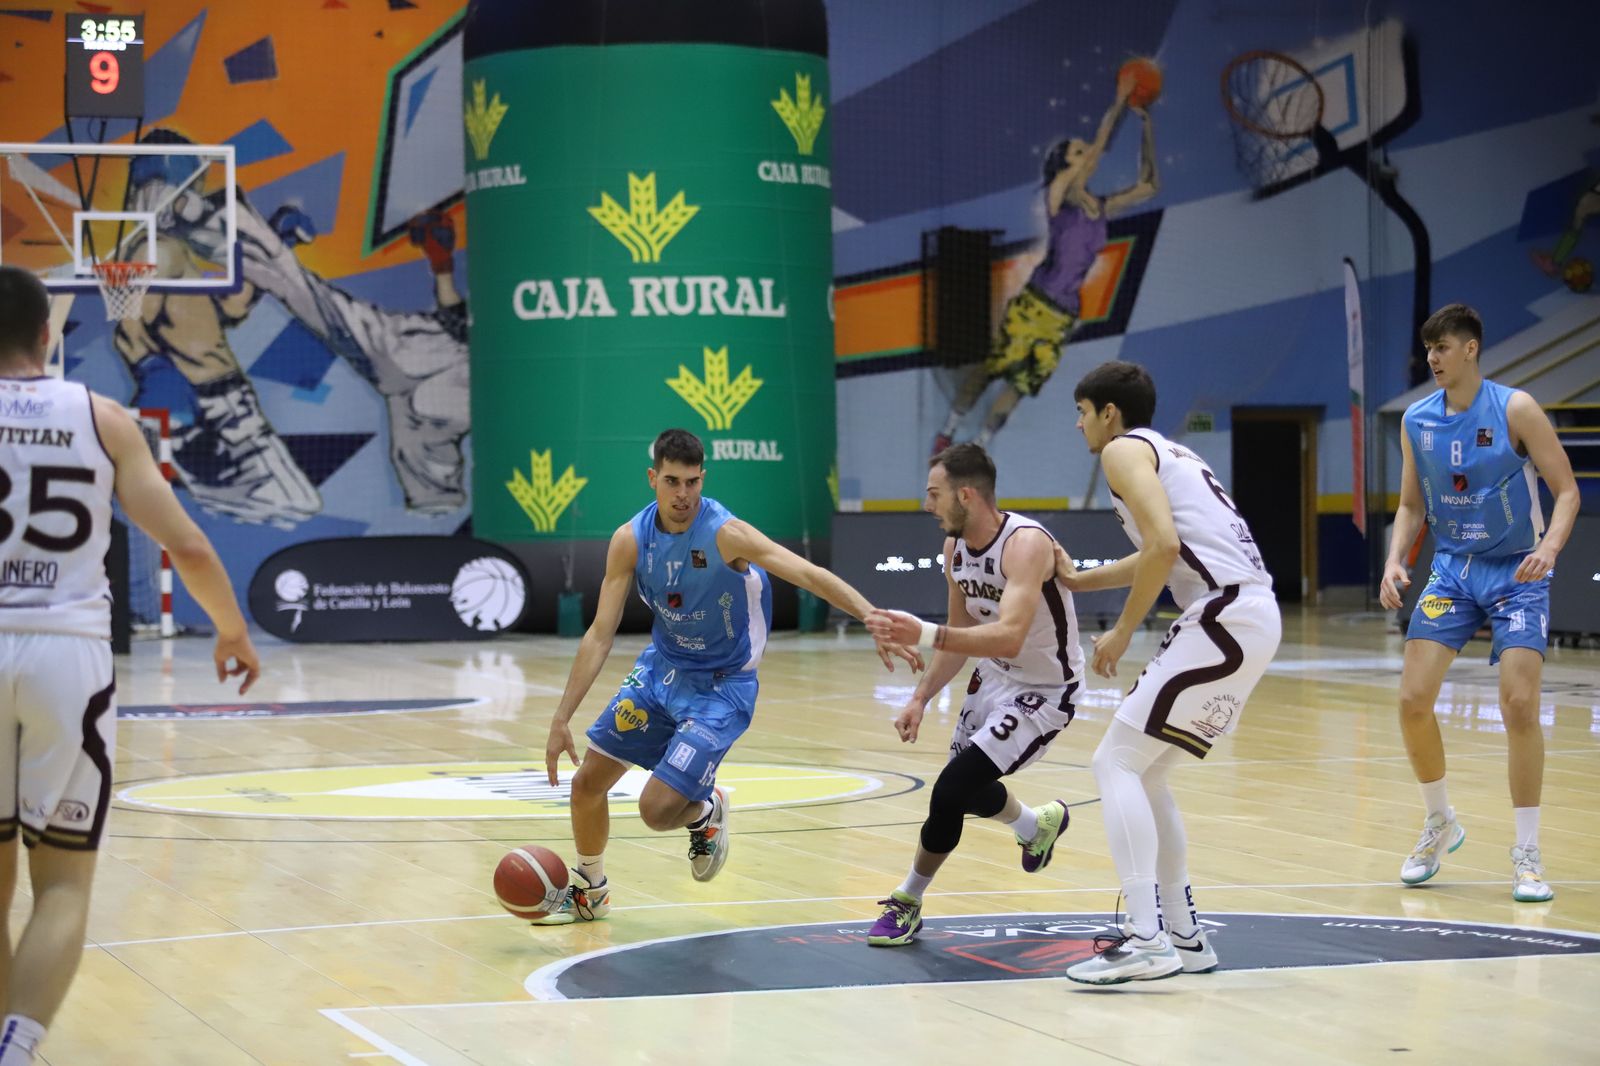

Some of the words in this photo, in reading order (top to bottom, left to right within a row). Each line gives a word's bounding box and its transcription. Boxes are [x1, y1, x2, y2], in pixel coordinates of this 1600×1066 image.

[81, 19, 136, 42] 3:55
[90, 51, 120, 94] 9
[758, 161, 798, 184] CAJA
[513, 277, 618, 320] CAJA
[629, 275, 787, 318] RURAL
[712, 440, 783, 461] RURAL
[1451, 440, 1462, 466] 8
[0, 464, 96, 552] 5
[666, 560, 683, 587] 17
[313, 583, 373, 597] Federación
[374, 582, 389, 595] de
[390, 581, 450, 595] Baloncesto
[313, 597, 328, 610] de
[329, 596, 370, 610] Castilla
[371, 599, 380, 611] y
[382, 595, 411, 608] León
[611, 701, 649, 733] ZAMORA
[990, 714, 1018, 741] 3
